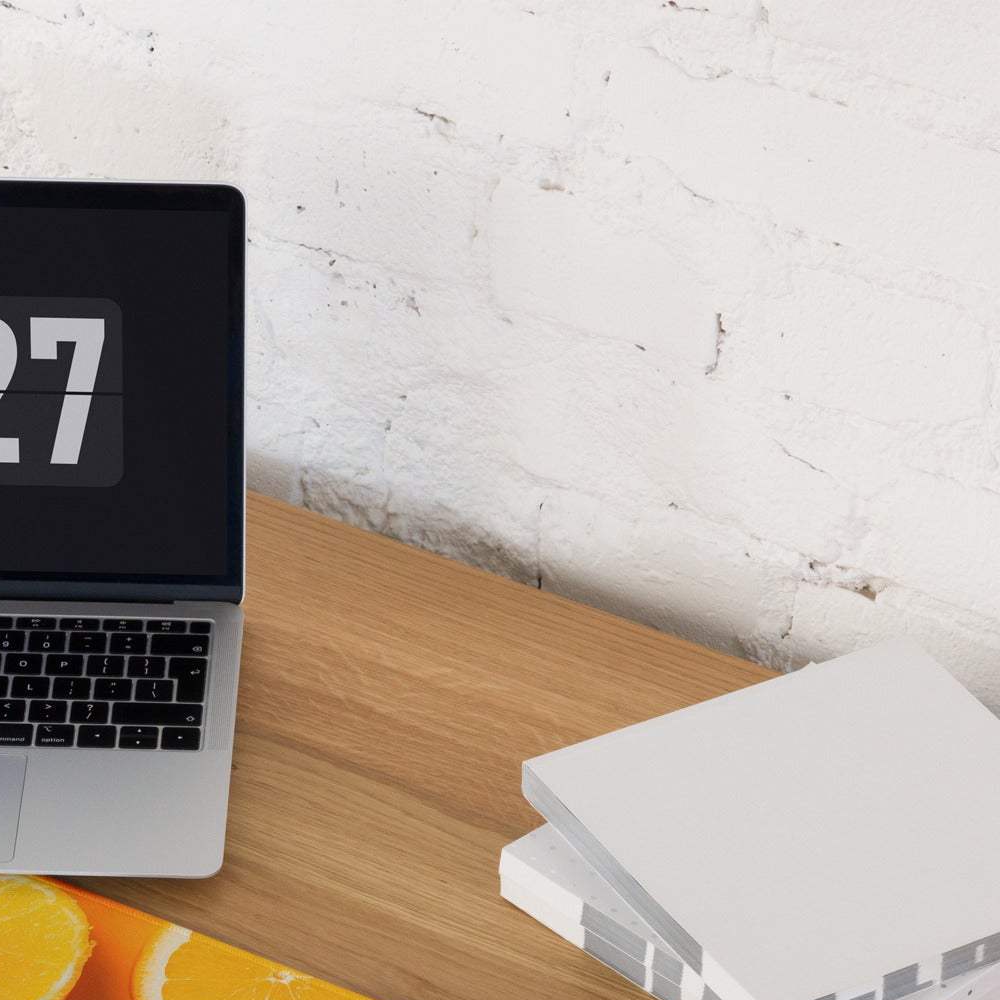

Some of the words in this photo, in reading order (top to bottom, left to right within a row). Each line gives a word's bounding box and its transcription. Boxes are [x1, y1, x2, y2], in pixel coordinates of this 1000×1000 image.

[2, 640, 10, 648] 9
[42, 641, 50, 649] 0
[27, 683, 33, 691] L
